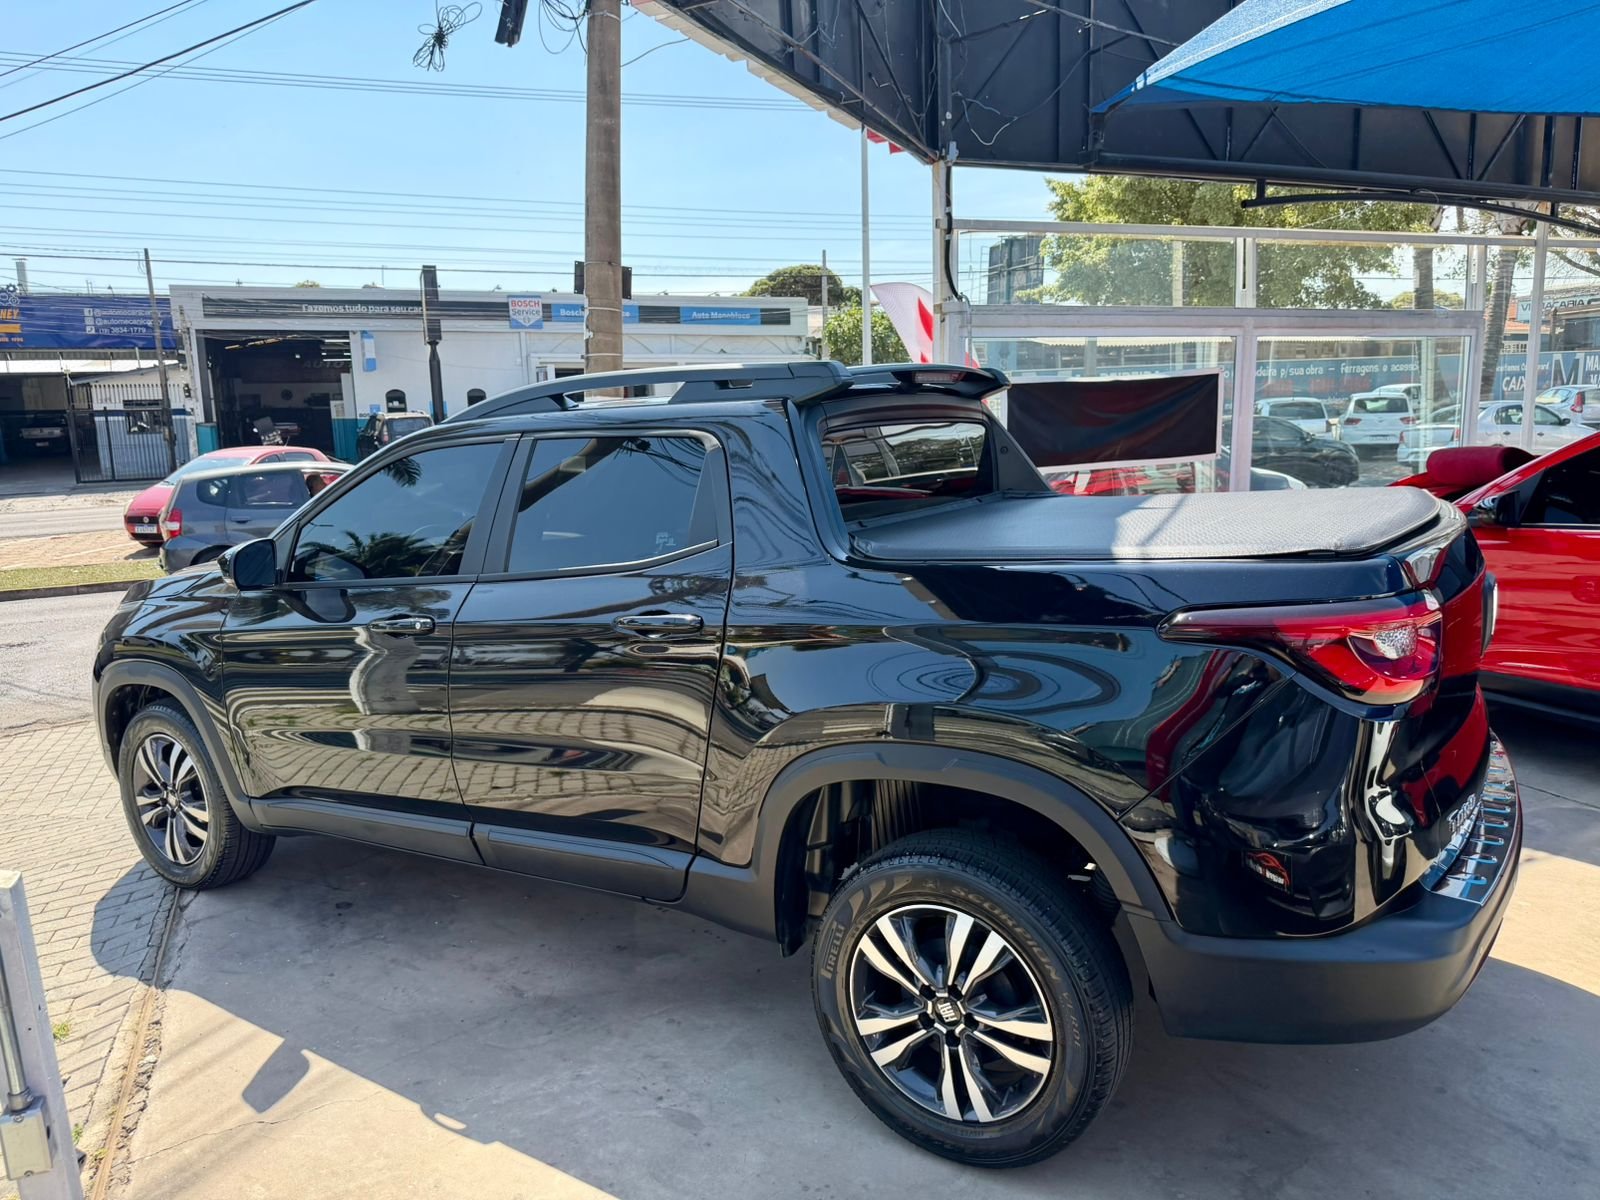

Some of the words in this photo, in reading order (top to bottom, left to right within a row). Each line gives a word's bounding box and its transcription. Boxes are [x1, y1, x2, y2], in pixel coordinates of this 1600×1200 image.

[511, 300, 540, 308] BOSCH
[345, 304, 367, 313] tudo
[368, 305, 389, 314] para
[511, 308, 541, 316] Service
[692, 311, 709, 319] Auto
[937, 1002, 958, 1023] FIAT
